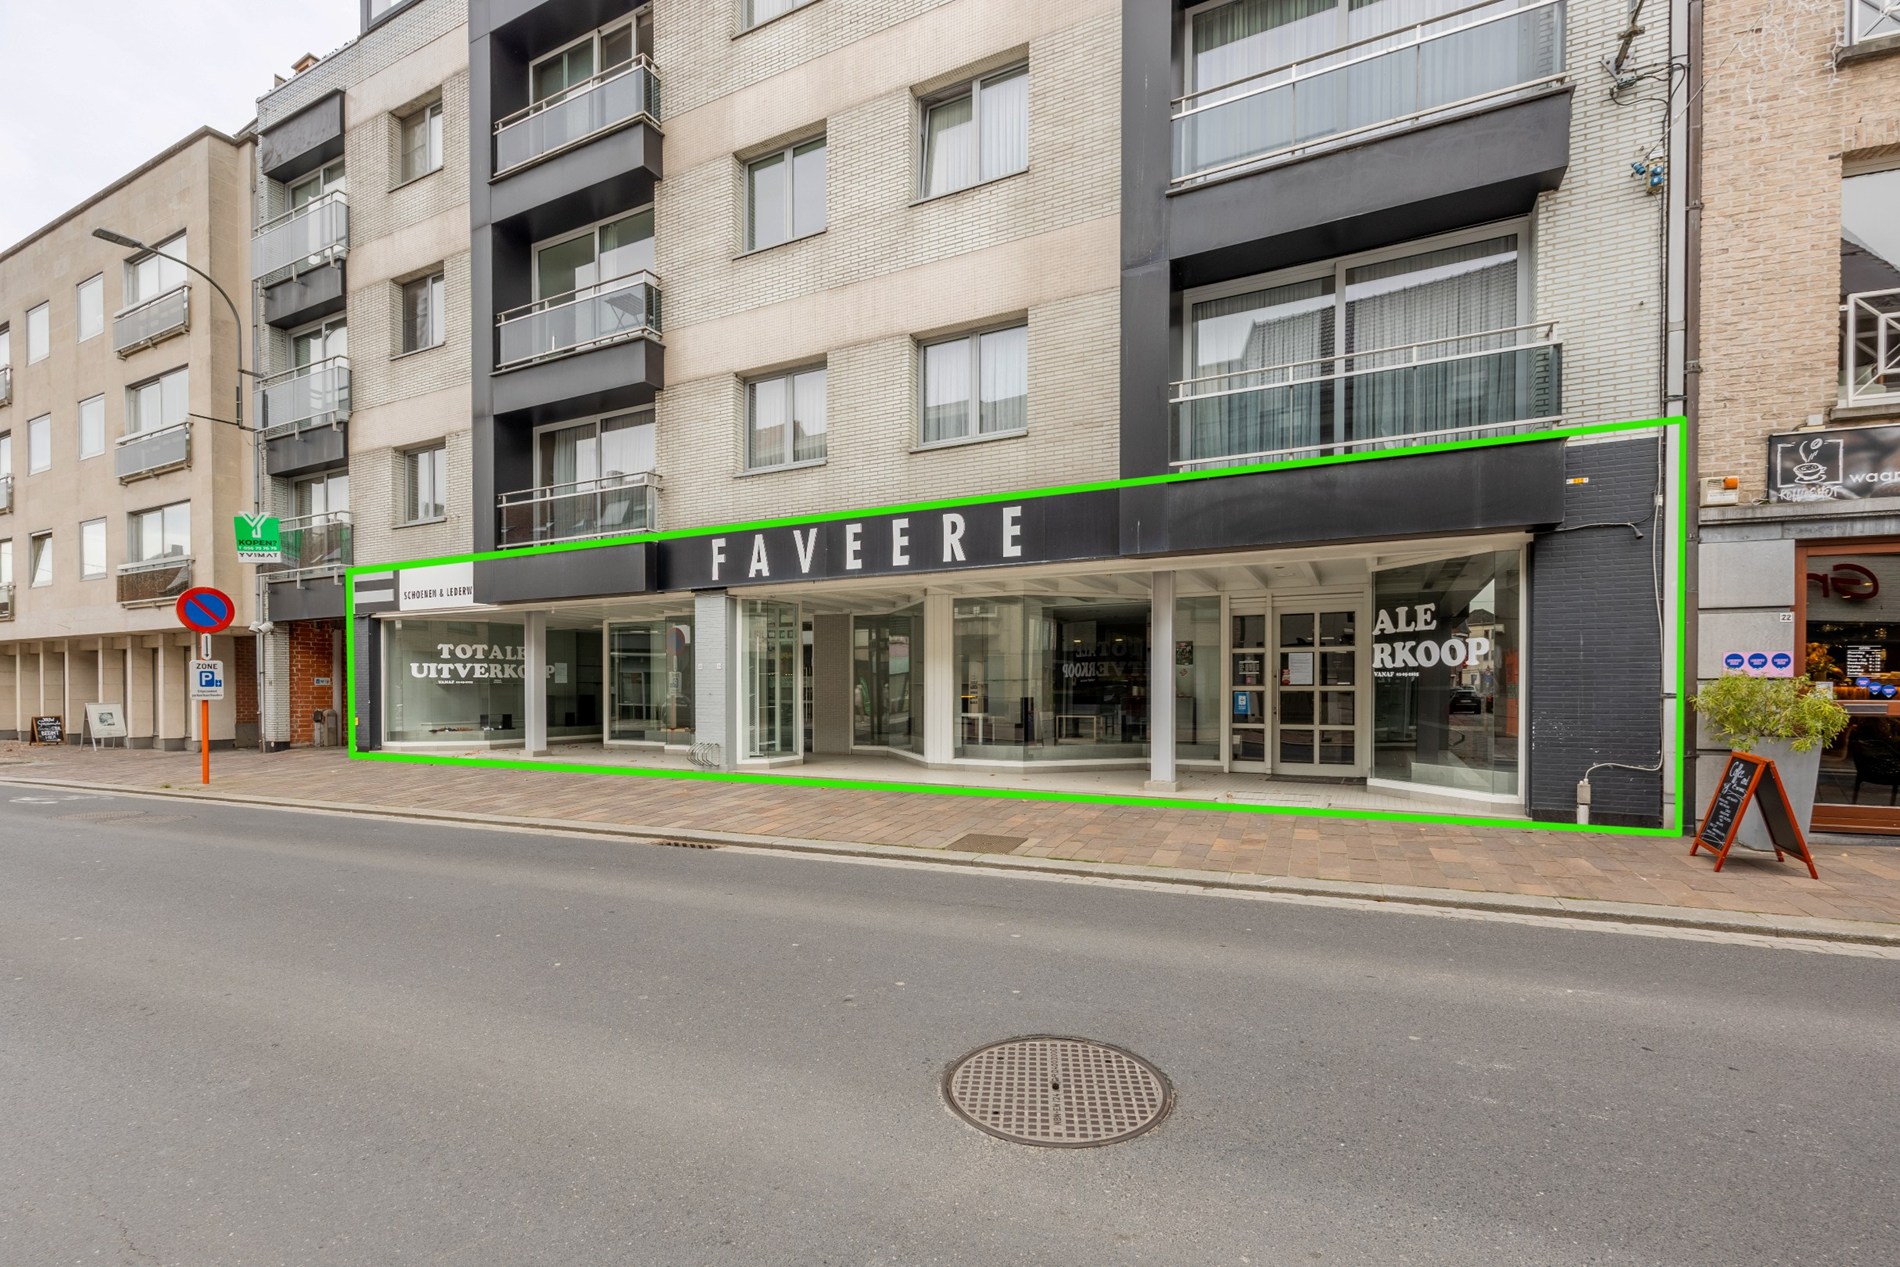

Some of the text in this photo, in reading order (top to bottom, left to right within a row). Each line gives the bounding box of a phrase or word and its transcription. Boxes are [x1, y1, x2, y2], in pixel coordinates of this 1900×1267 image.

[711, 505, 1022, 582] FAVEERE
[404, 589, 437, 600] SCHOENEN
[439, 588, 444, 598] &
[1372, 603, 1437, 635] ALE
[1372, 637, 1490, 668] RKOOP
